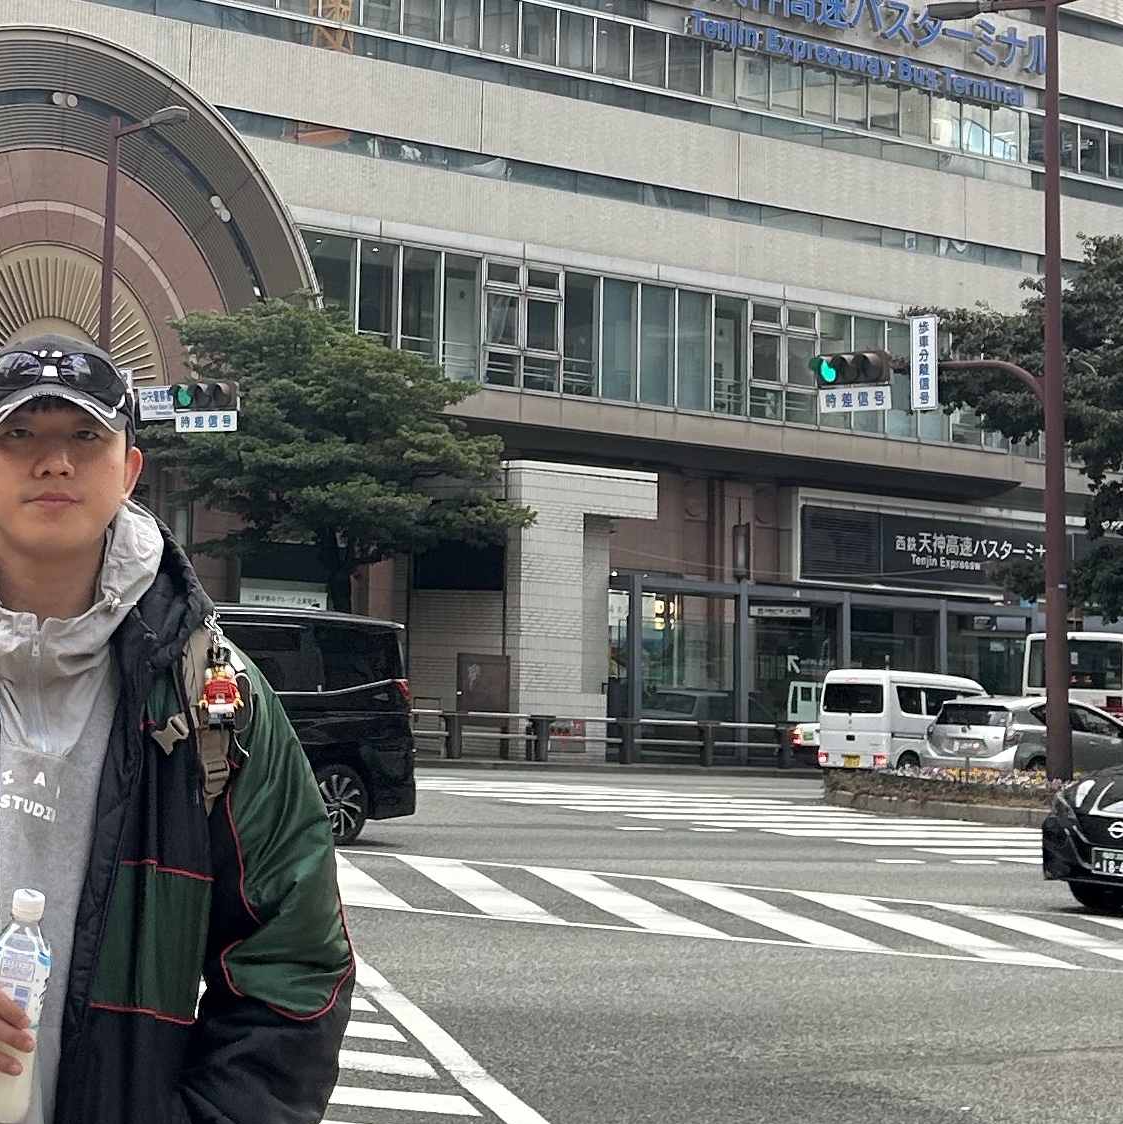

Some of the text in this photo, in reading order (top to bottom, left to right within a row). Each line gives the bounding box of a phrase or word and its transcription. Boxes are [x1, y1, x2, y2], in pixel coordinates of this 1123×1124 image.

[692, 10, 1025, 108] Tenjin Expressway Bus Terminal
